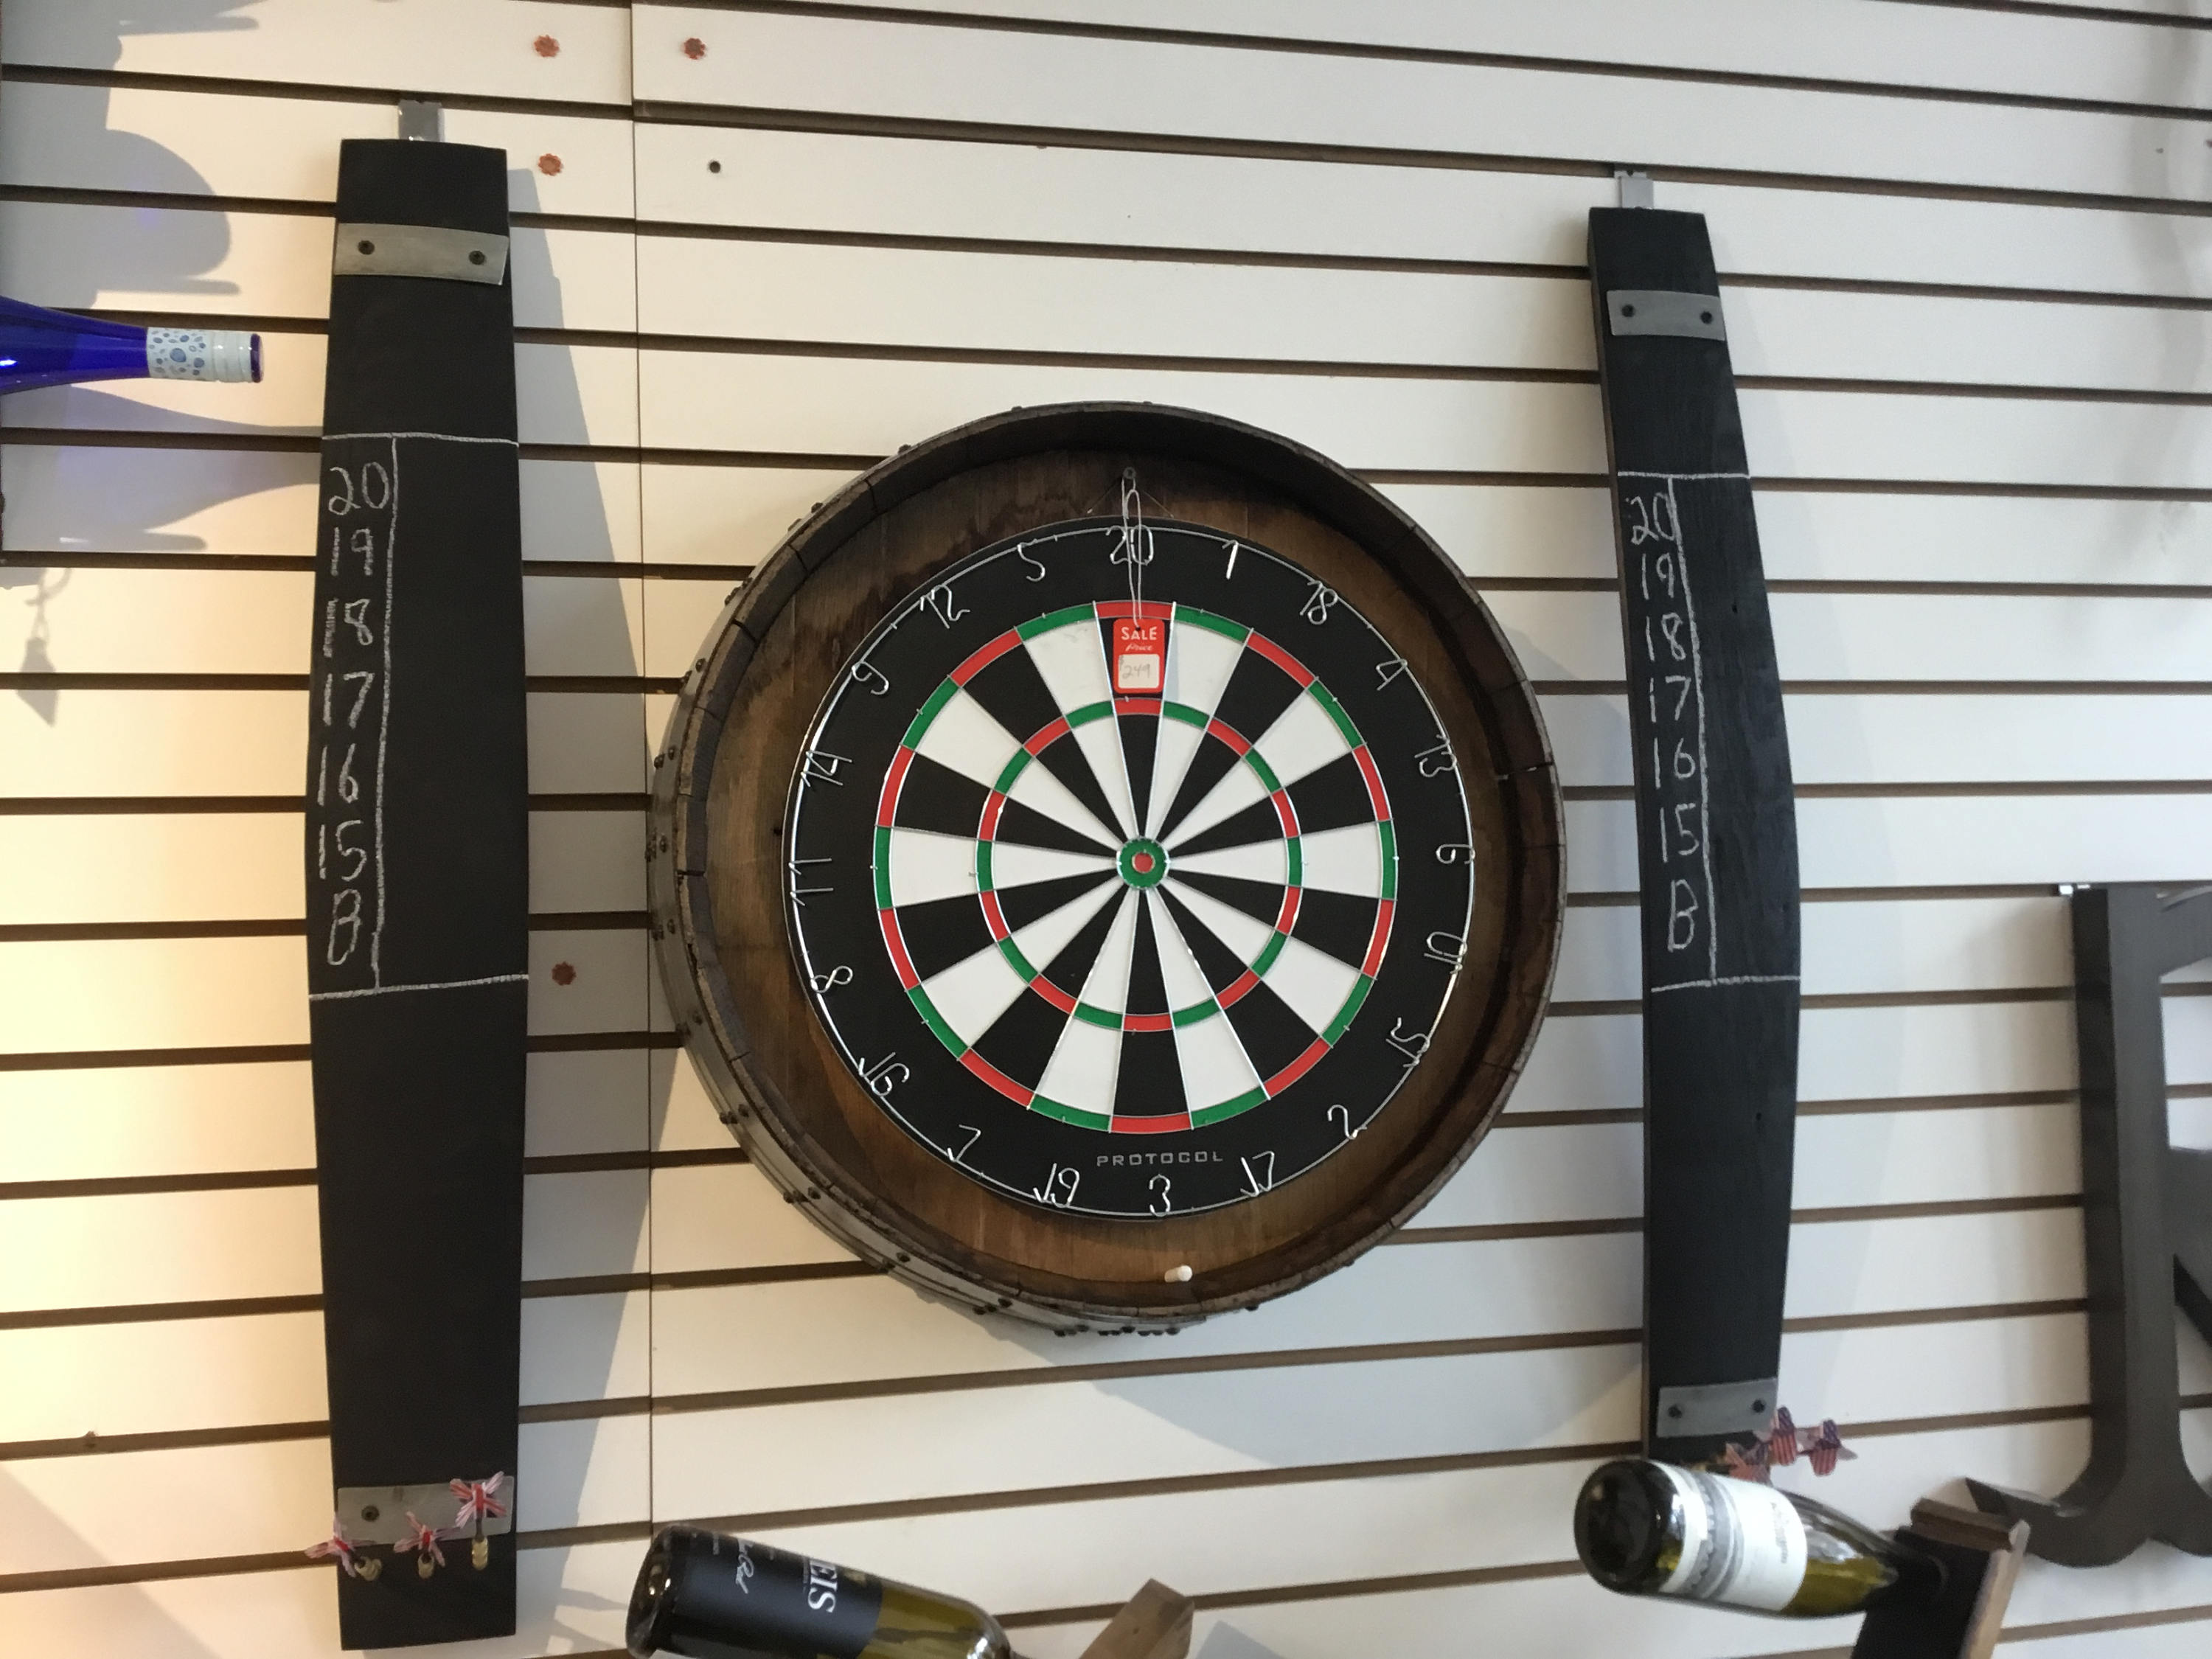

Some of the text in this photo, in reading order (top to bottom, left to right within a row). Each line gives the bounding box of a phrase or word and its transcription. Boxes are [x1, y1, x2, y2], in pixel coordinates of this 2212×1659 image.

[327, 462, 390, 515] 20
[1630, 492, 1677, 546] 20
[330, 526, 374, 576] 19
[1017, 539, 1046, 582] 5
[1106, 524, 1154, 566] 20
[1222, 539, 1239, 580] 1
[1641, 552, 1674, 600] 19
[920, 585, 970, 629] 12
[1300, 580, 1339, 625] 18
[322, 597, 373, 658] 18
[1121, 626, 1158, 641] SALE
[1645, 612, 1686, 662] 18
[852, 661, 890, 695] 9
[1376, 658, 1408, 691] 4
[322, 671, 376, 729] 17
[1649, 675, 1692, 723] 17
[317, 742, 359, 807] 16
[800, 749, 853, 787] 14
[1414, 734, 1458, 778] 13
[1654, 737, 1696, 790] 16
[318, 819, 368, 882] 15
[1659, 802, 1700, 864] 15
[788, 858, 834, 907] 11
[1666, 878, 1699, 953] B
[1423, 931, 1468, 975] 10
[810, 965, 853, 994] 8
[1385, 1017, 1430, 1068] 15
[858, 1051, 910, 1096] 16
[947, 1124, 982, 1163] 7
[1327, 1105, 1367, 1140] 2
[1096, 1150, 1223, 1167] PROTOCOL
[1240, 1151, 1275, 1197] 17
[1033, 1163, 1080, 1208] 19
[1149, 1173, 1171, 1217] 3
